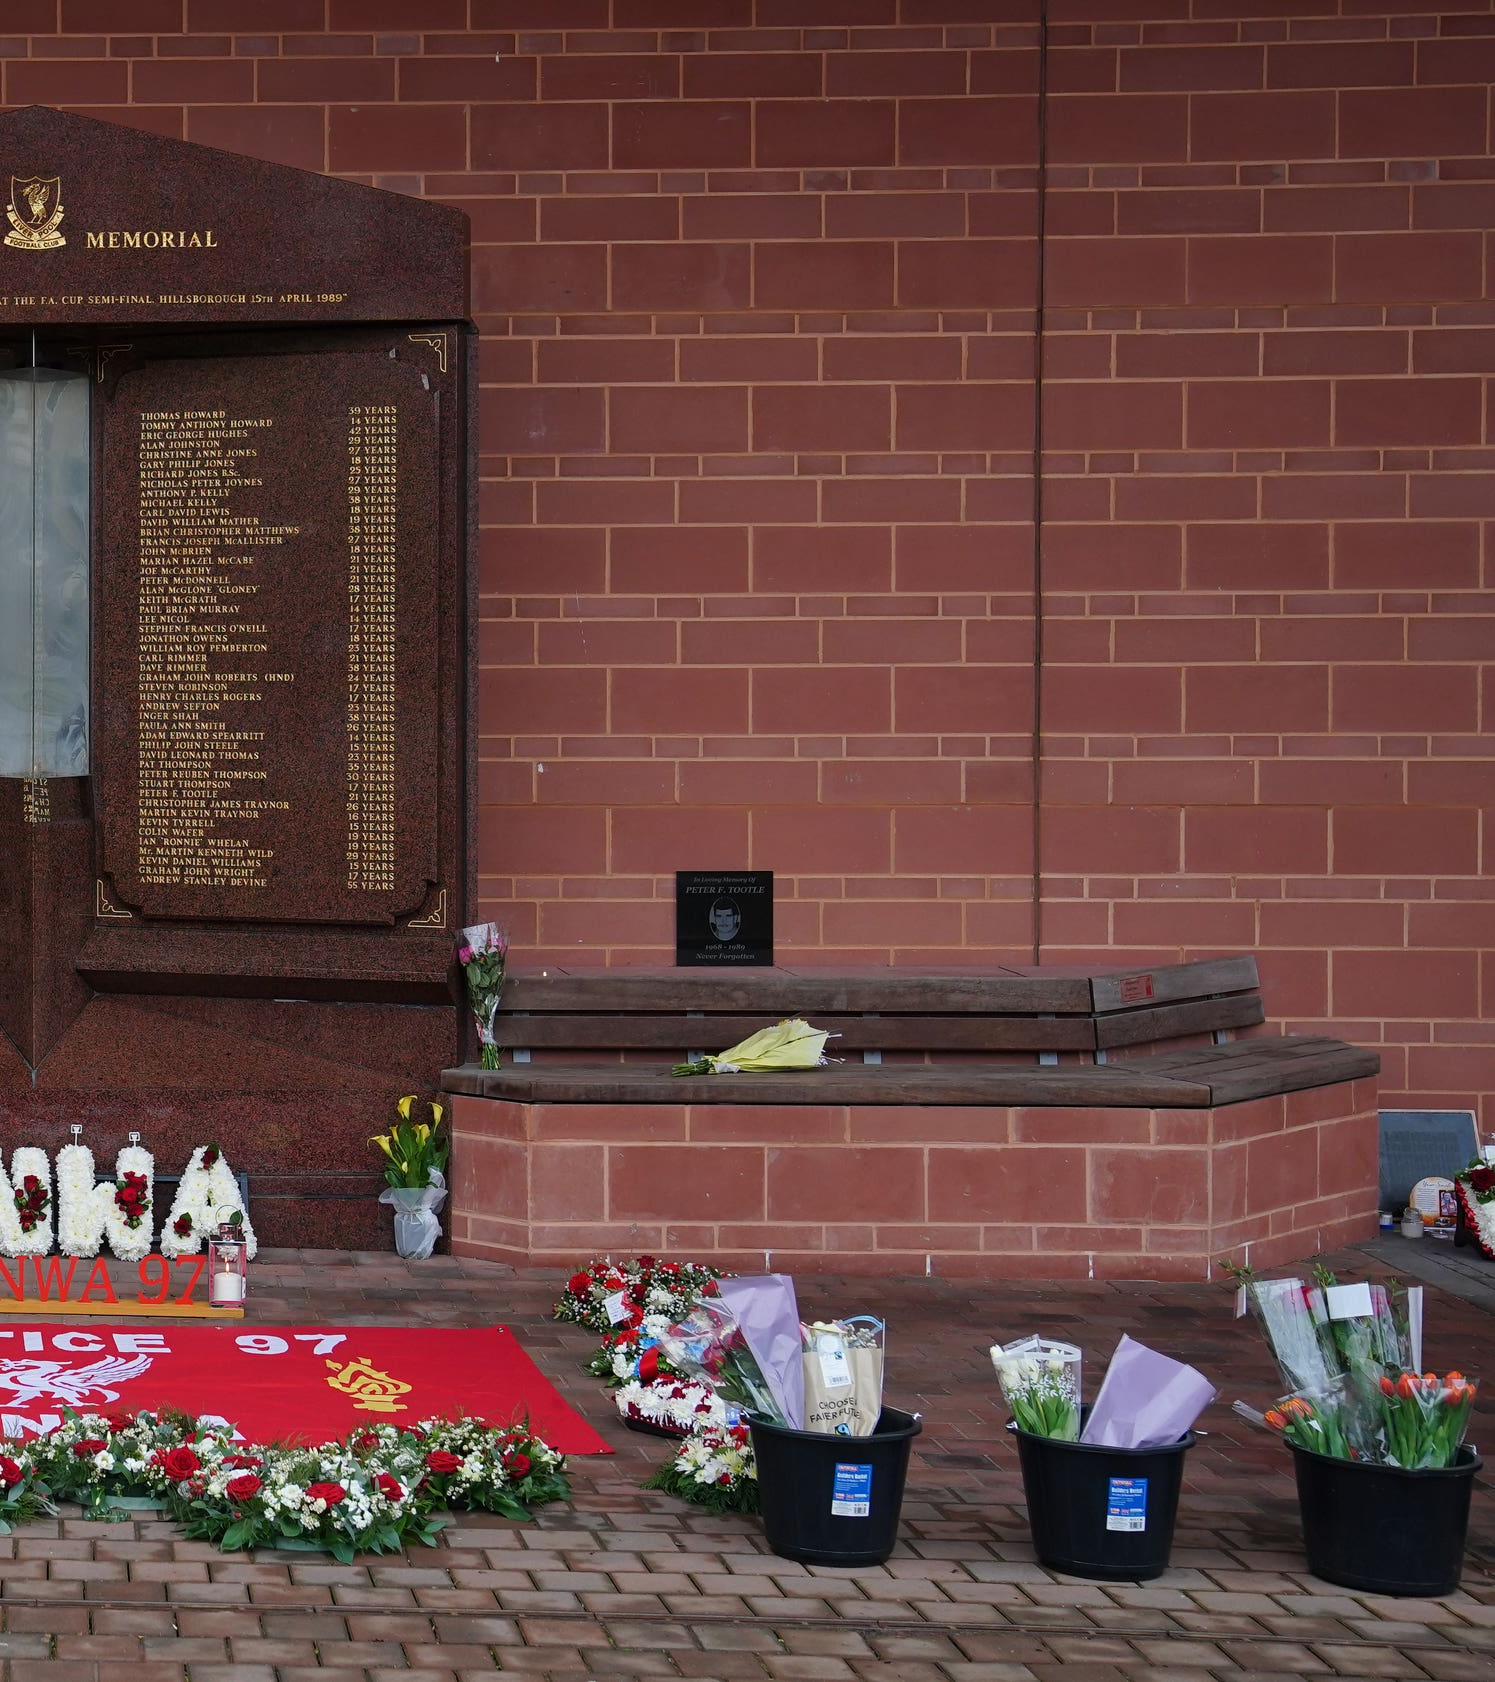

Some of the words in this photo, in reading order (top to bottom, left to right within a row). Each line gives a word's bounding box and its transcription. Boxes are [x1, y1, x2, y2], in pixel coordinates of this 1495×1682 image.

[13, 219, 33, 237] LIVER
[38, 221, 58, 238] POOL
[10, 238, 41, 248] FOOTBALL
[44, 240, 59, 248] CLUB
[87, 231, 217, 248] MEMORIAL
[14, 297, 36, 305] THE
[62, 296, 83, 304] CUP
[160, 294, 246, 303] HILLSBOROUGH
[279, 294, 312, 302] APRIL
[141, 412, 180, 420] THOMAS
[184, 411, 226, 419] HOWARD
[348, 407, 361, 415] 39
[364, 406, 397, 414] YEARS
[139, 451, 192, 459] CHRISTINE
[196, 450, 223, 458] ANNE
[226, 449, 257, 457] JONES
[348, 447, 361, 455] 27
[364, 446, 397, 454] YEARS
[140, 499, 184, 507] MICHAEL
[349, 496, 361, 504] 38
[364, 495, 396, 503] YEARS
[139, 596, 168, 604] KEITH
[350, 595, 360, 603] 17
[363, 594, 395, 602] YEARS
[350, 634, 360, 642] 18
[363, 634, 395, 642] YEARS
[139, 683, 174, 691] STEVEN
[178, 683, 227, 691] ROBINSON
[349, 684, 359, 692] 17
[363, 684, 395, 692] YEARS
[171, 751, 215, 759] LEONARD
[348, 753, 359, 761] 23
[362, 753, 395, 761] YEARS
[178, 780, 231, 788] THOMPSON
[349, 783, 359, 792] 17
[362, 783, 394, 791] YEARS
[139, 818, 169, 826] KEVIN
[172, 819, 215, 827] TYRRELL
[350, 822, 359, 830] 15
[362, 823, 394, 831] YEARS
[184, 877, 226, 885] STANLEY
[231, 878, 267, 886] DEVINE
[347, 881, 358, 889] 55
[361, 882, 394, 890] YEARS
[138, 1254, 207, 1305] 97
[235, 1334, 347, 1355] 97
